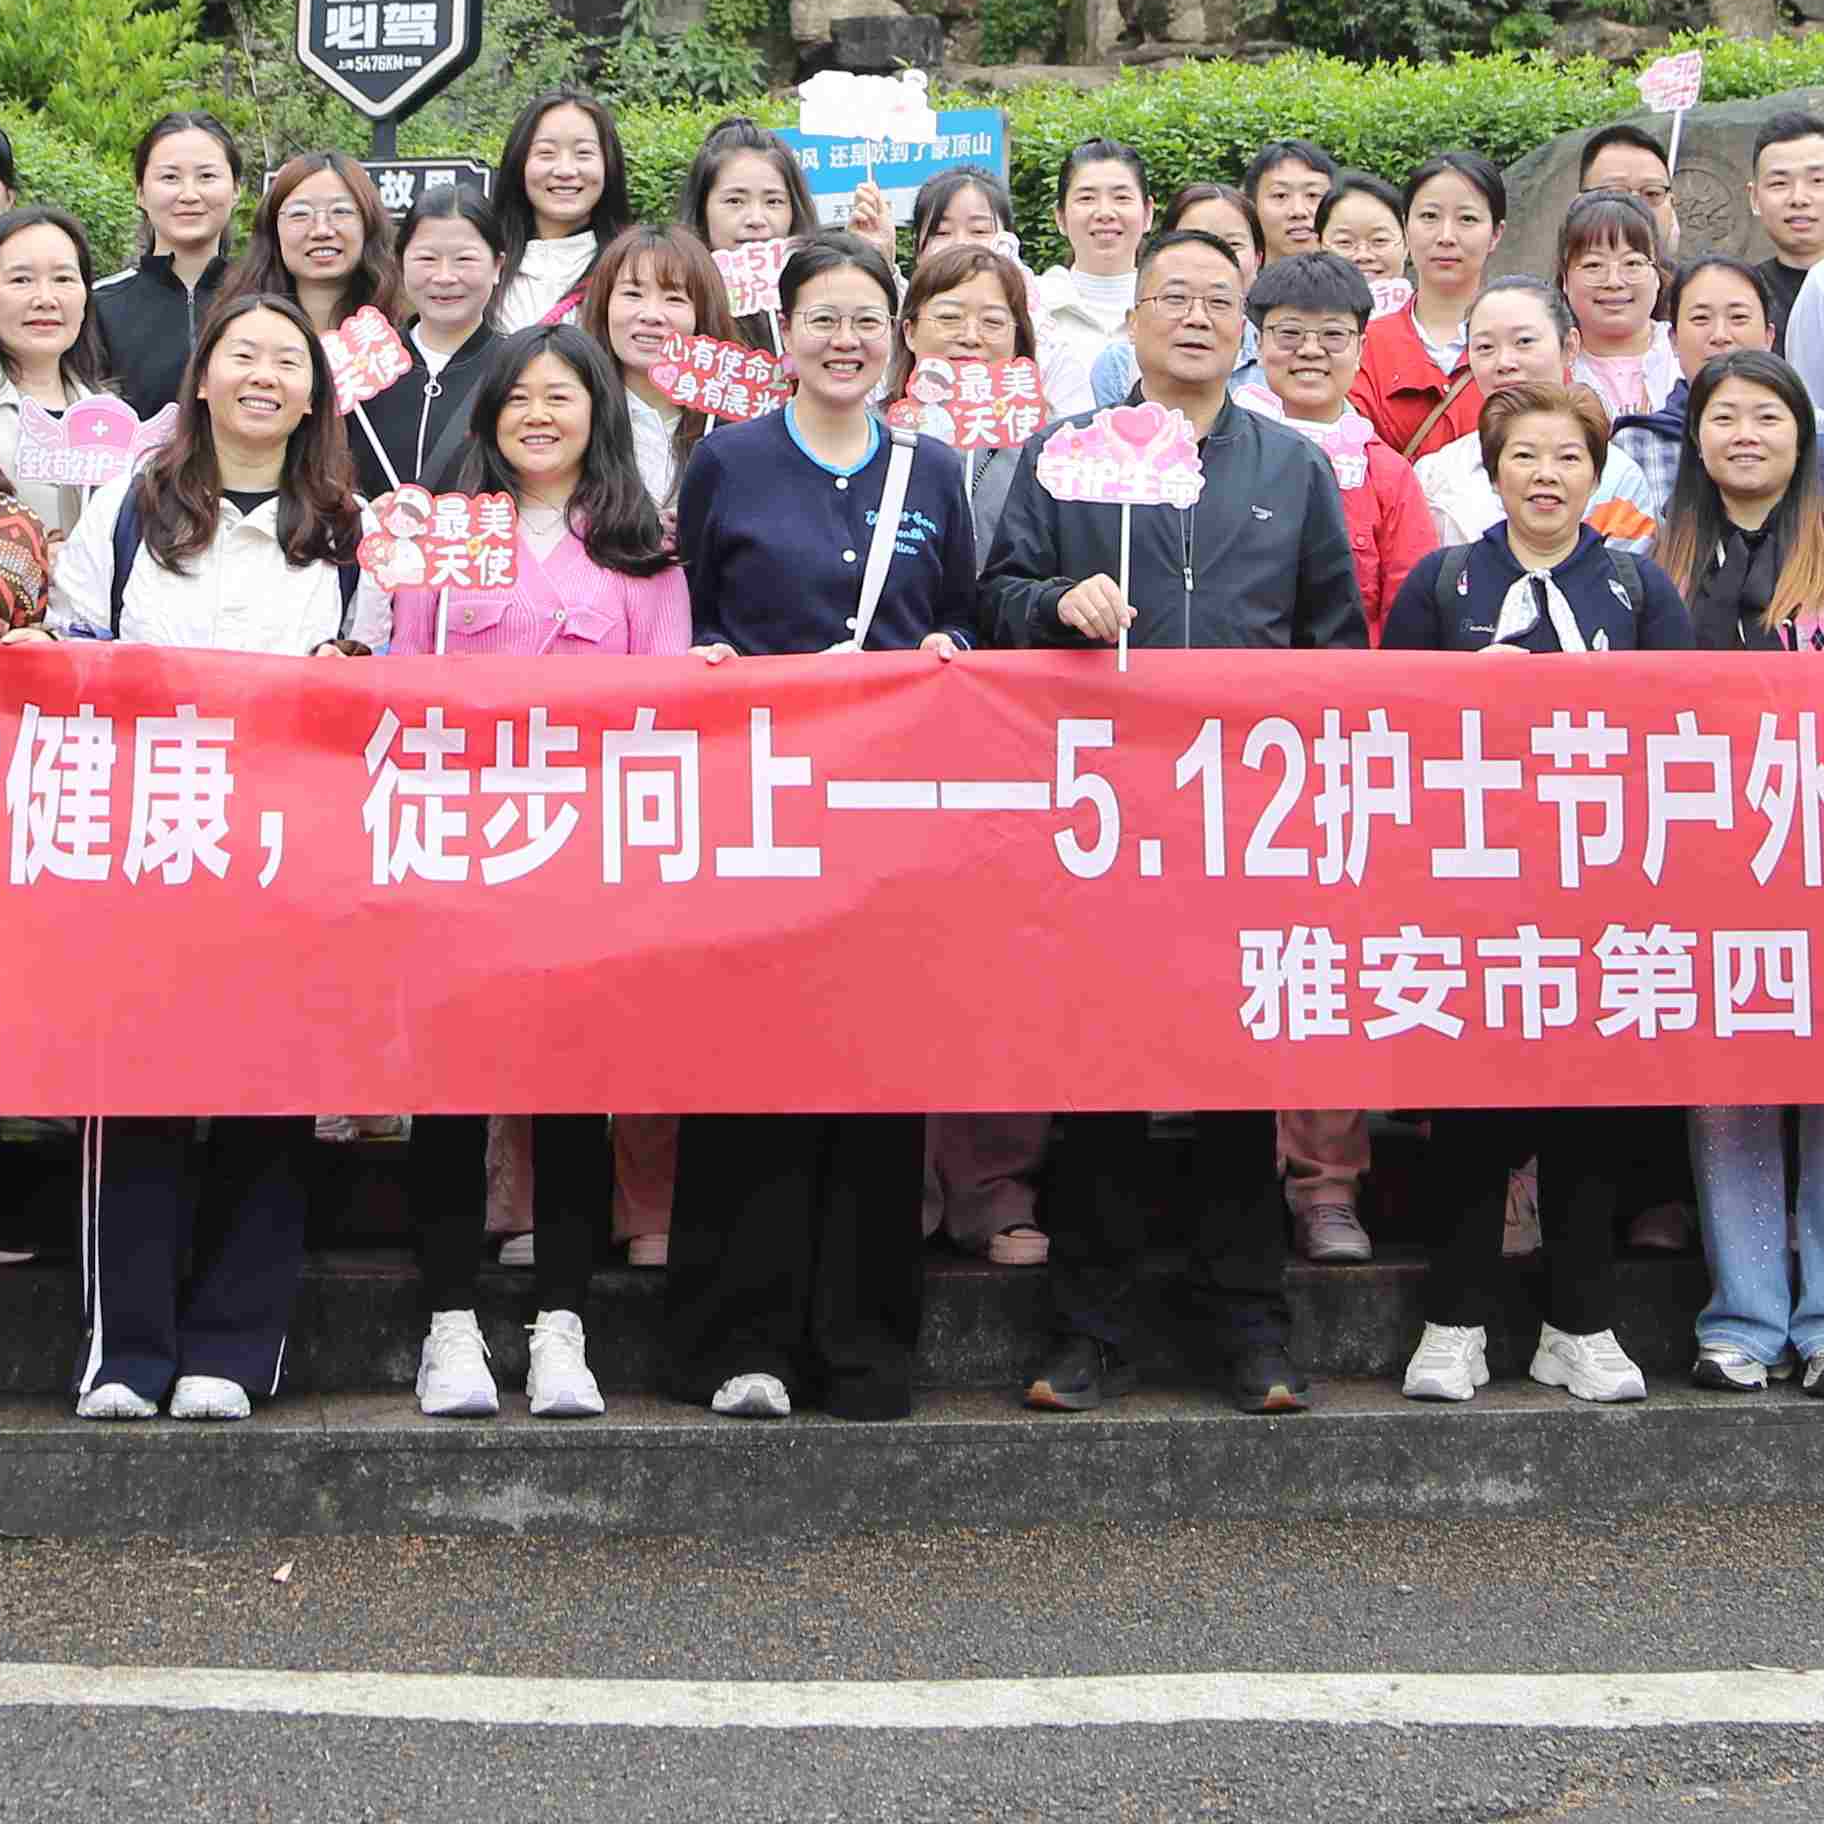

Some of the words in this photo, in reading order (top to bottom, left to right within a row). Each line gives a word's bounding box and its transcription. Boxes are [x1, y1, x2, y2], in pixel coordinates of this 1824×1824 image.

[324, 3, 437, 49] 必驾
[355, 54, 403, 72] 5476KM
[662, 332, 773, 384] 心有使命
[673, 372, 780, 419] 身有晨光
[958, 363, 1040, 404] 最美
[960, 405, 1041, 445] 天使
[430, 497, 513, 541] 最美
[429, 544, 513, 585] 天使
